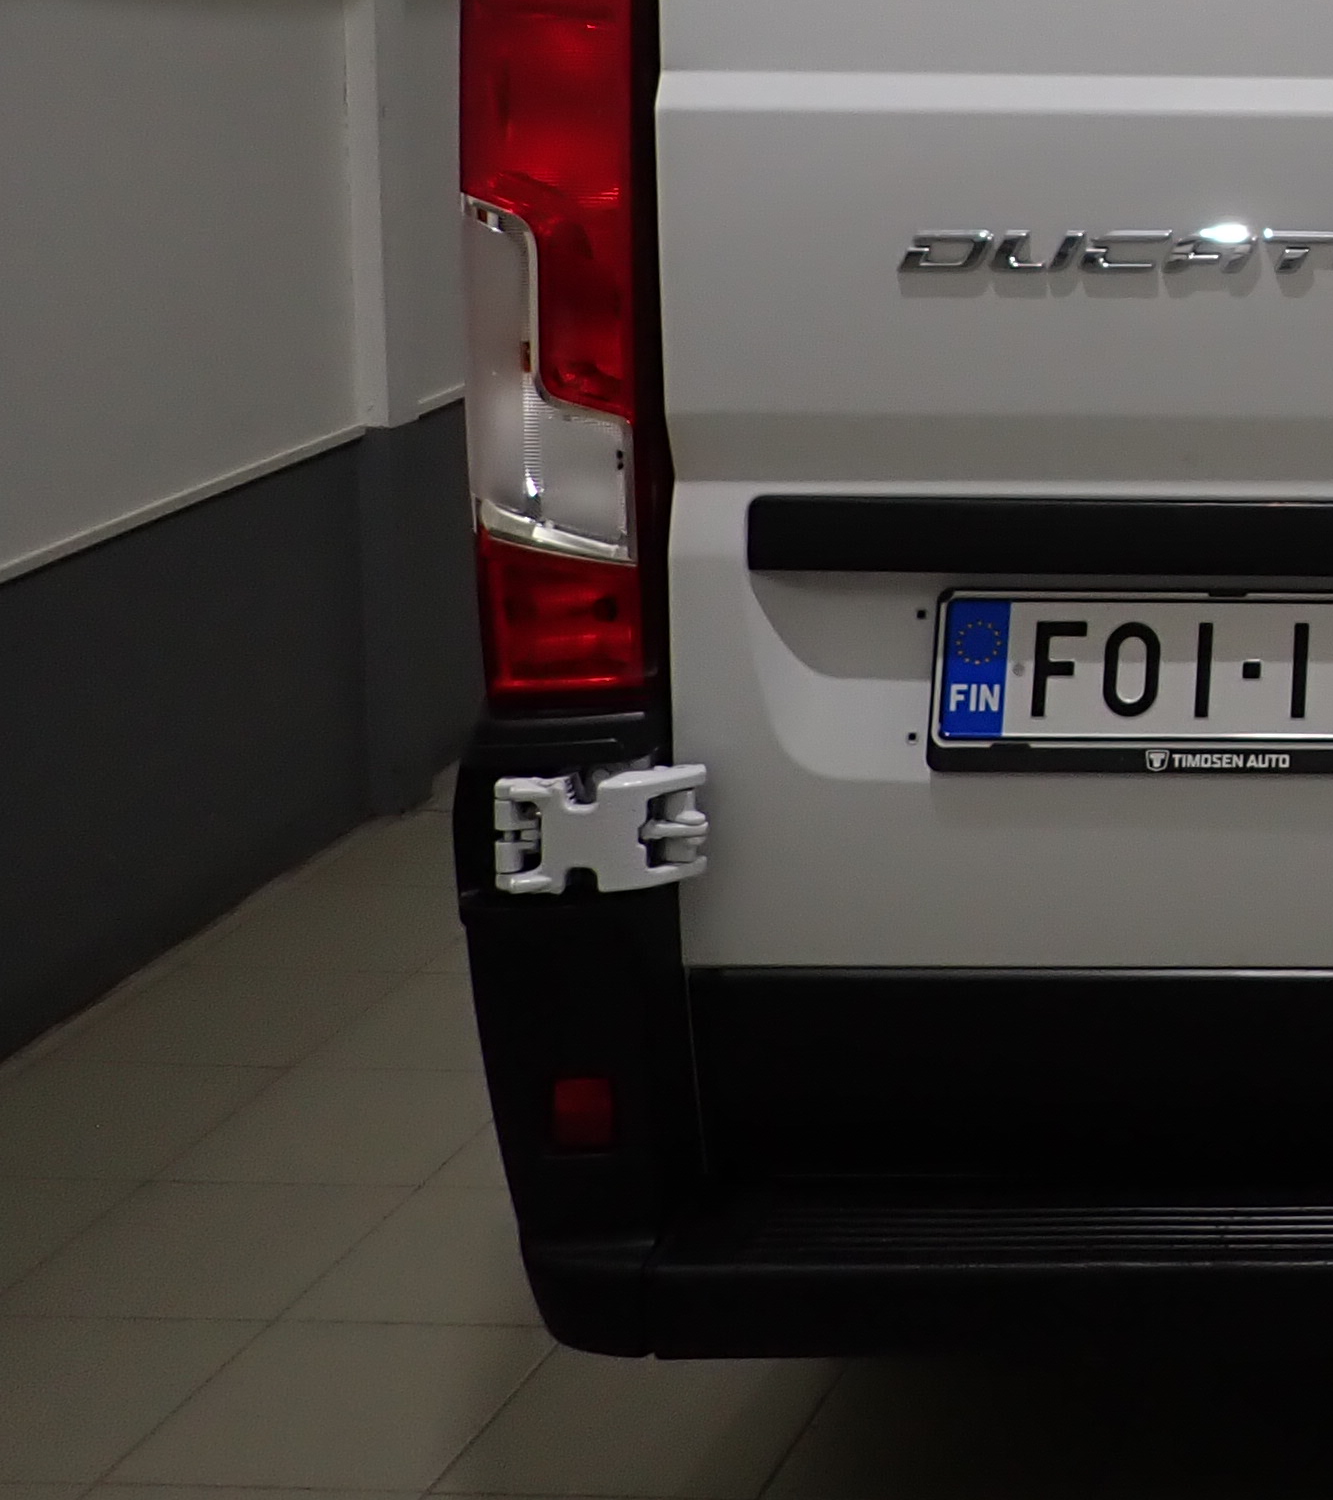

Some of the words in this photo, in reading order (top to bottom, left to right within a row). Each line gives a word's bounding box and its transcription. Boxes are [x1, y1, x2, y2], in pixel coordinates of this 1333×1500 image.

[949, 683, 1000, 712] FIN
[1172, 753, 1244, 768] TIMOSEN
[1246, 753, 1290, 768] AUTO
